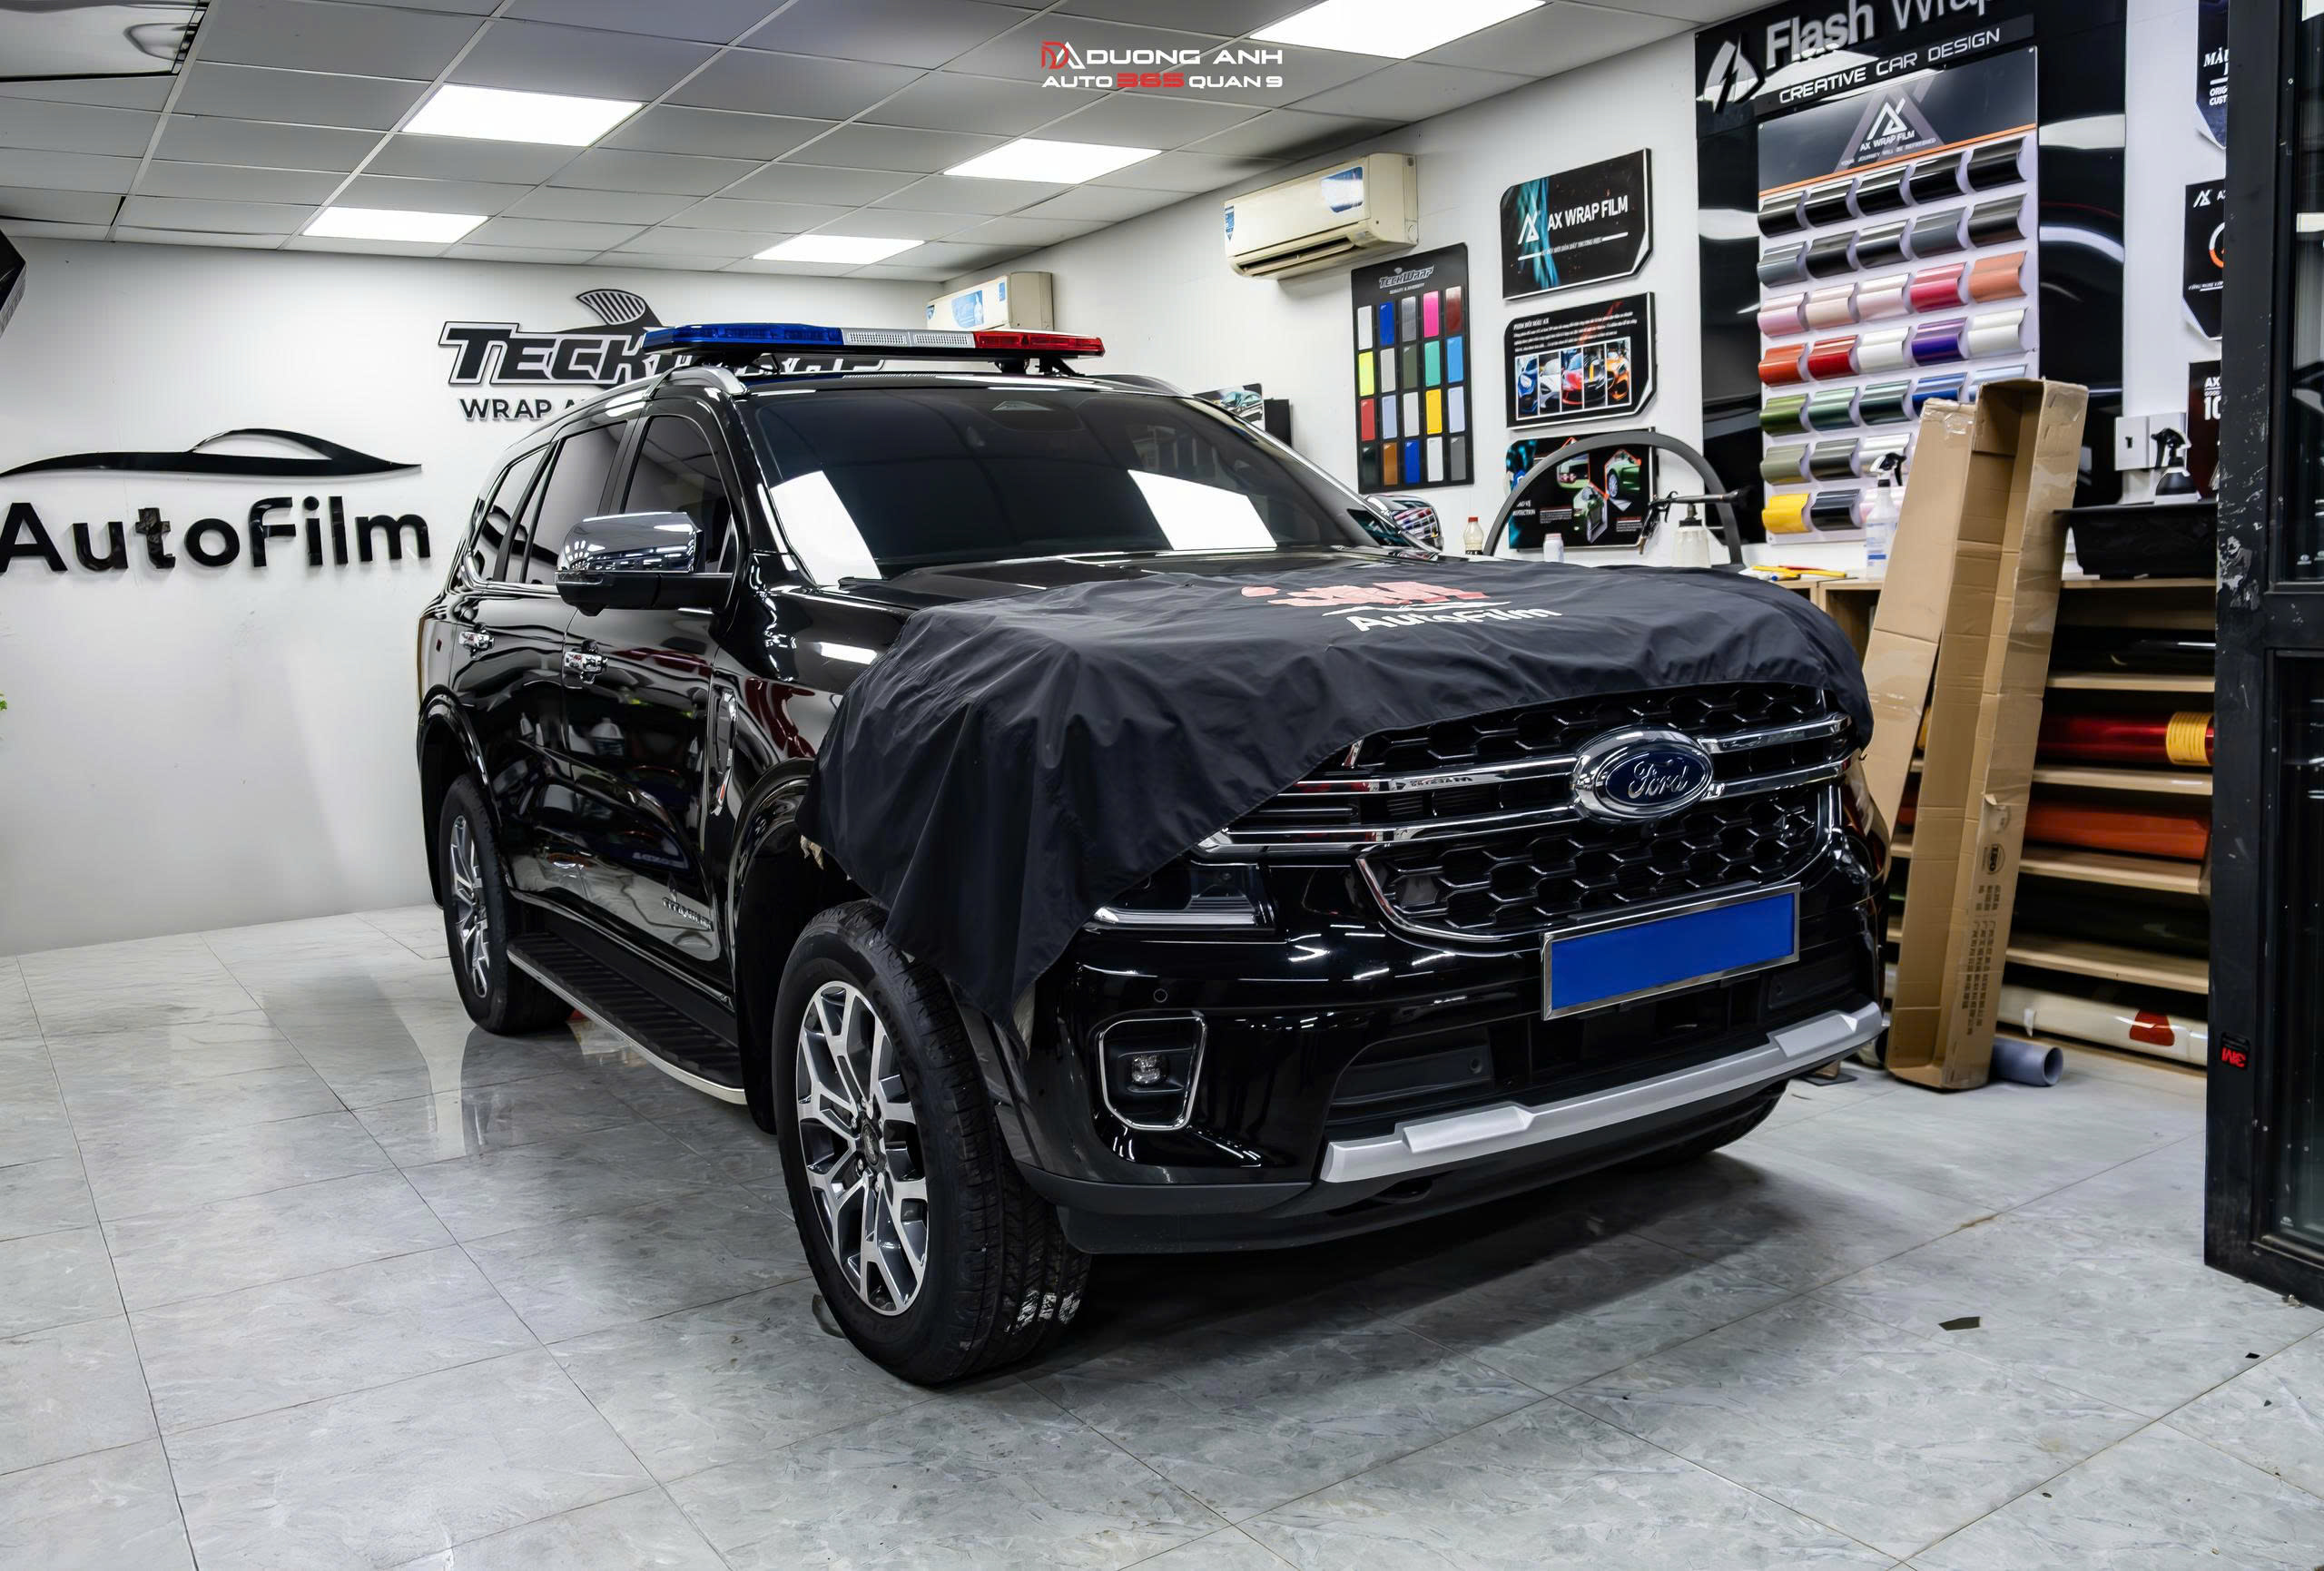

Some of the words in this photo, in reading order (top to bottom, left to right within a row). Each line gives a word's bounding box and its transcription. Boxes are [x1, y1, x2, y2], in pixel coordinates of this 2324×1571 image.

[1766, 0, 1876, 70] Flash
[1778, 67, 1867, 104] CREATIVE
[1876, 53, 1918, 77] CAR
[1927, 27, 2001, 63] DESIGN
[1873, 134, 1896, 147] WRAP
[1547, 211, 1563, 231] AX
[1564, 202, 1600, 227] WRAP
[1601, 194, 1629, 219] FILM
[458, 398, 552, 420] WRAP
[0, 496, 431, 574] AutoFilm
[1346, 608, 1562, 632] AutoFilm
[1628, 761, 1689, 799] Ford
